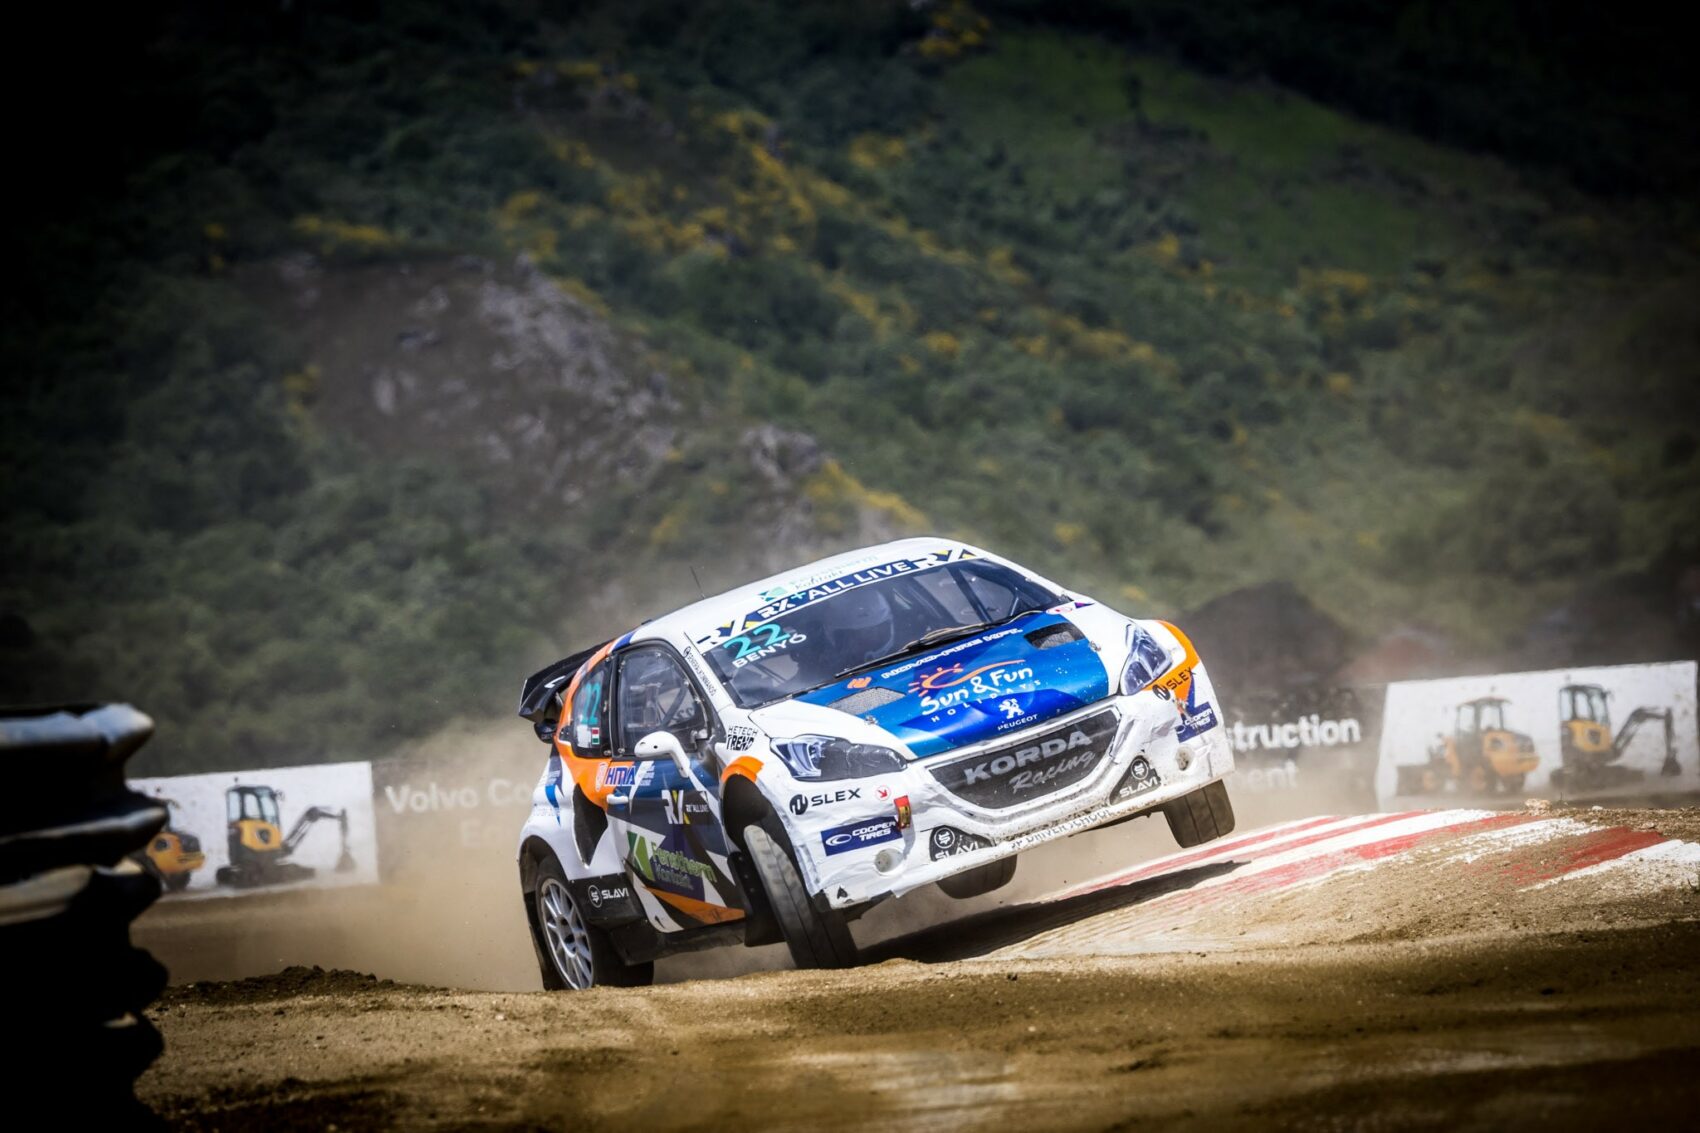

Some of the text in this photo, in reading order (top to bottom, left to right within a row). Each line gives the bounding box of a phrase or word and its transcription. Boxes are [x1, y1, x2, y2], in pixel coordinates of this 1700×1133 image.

[808, 579, 854, 600] ALL
[854, 561, 911, 582] LIVE
[723, 623, 791, 659] 22
[1166, 667, 1197, 691] SLEX
[920, 667, 1033, 715] Sun & Fun
[931, 679, 1041, 722] HOLIDAYS
[998, 713, 1038, 731] PEUGEOT
[1184, 708, 1213, 725] COOPER
[1191, 717, 1211, 729] TIRES
[728, 725, 759, 735] HETECH
[726, 734, 755, 751] TREND
[963, 730, 1093, 785] KORDA
[604, 765, 636, 786] HMA
[1008, 750, 1096, 794] Racing
[384, 781, 479, 815] Volvo
[810, 788, 861, 807] SLEX
[1119, 778, 1159, 798] SLAVI
[851, 820, 896, 837] COOPER
[859, 828, 892, 842] TIRES
[601, 887, 630, 899] SLAVI
